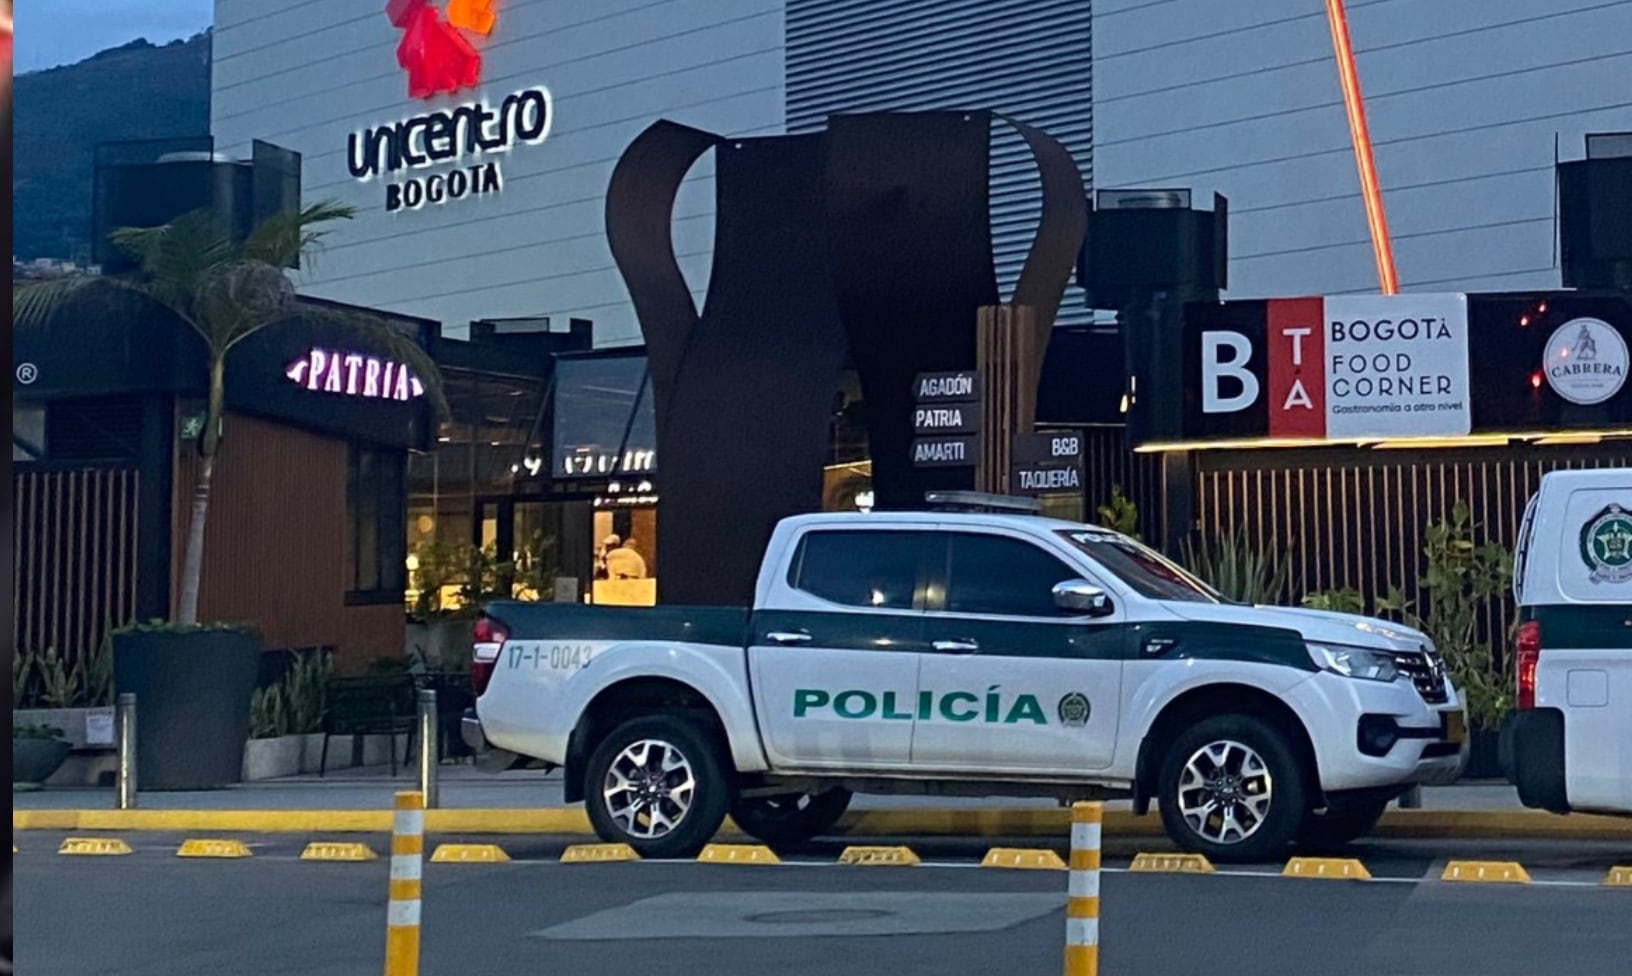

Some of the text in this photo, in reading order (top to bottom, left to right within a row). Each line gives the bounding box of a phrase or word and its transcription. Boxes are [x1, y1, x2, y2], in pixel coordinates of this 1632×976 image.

[1332, 353, 1412, 374] FOOD
[1551, 362, 1622, 379] CABRERA
[306, 348, 409, 401] PATRIA
[919, 374, 972, 397] AGADÓN
[1332, 375, 1452, 397] CORNER
[1437, 400, 1464, 411] nivel
[916, 409, 962, 427] PATRIA
[914, 442, 965, 462] AMARTI
[1052, 438, 1079, 456] B&B
[1019, 467, 1079, 489] TAQUERÍA
[509, 645, 593, 669] 17-1-0043
[793, 684, 1049, 725] POLICÍA
